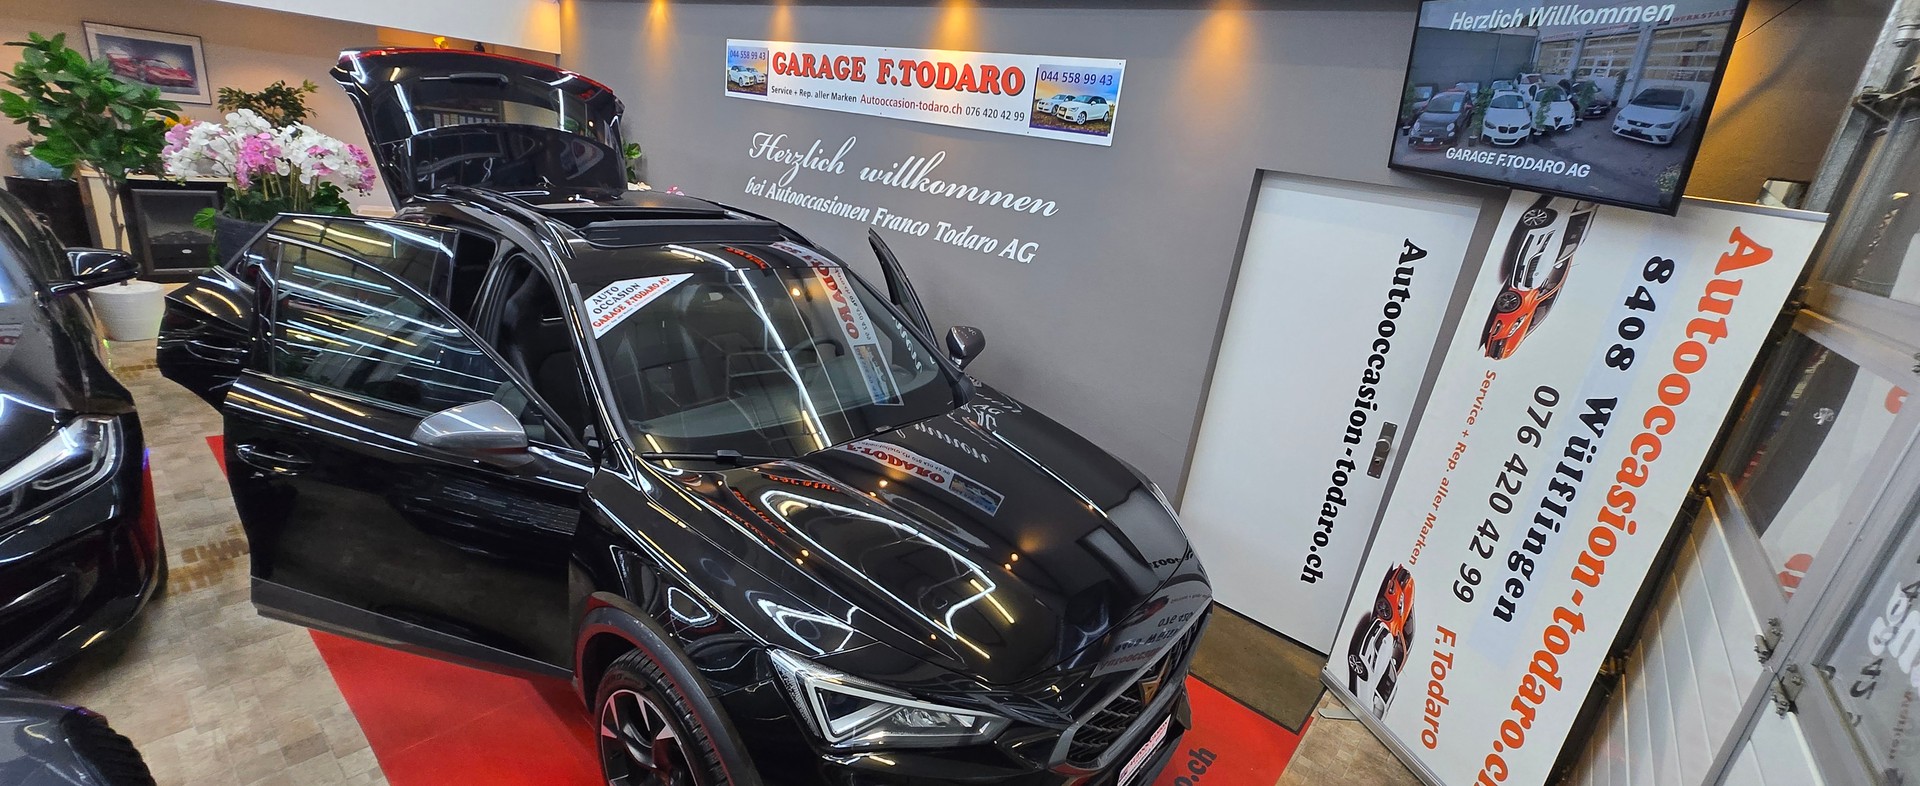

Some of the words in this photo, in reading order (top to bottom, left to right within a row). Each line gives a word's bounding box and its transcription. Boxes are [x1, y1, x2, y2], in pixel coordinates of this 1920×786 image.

[1449, 7, 1524, 31] Herzlich
[1528, 4, 1676, 27] Willkommen
[729, 50, 740, 58] 044
[740, 51, 750, 59] 558
[751, 51, 758, 60] 99
[758, 52, 766, 60] 43
[772, 51, 867, 83] GARAGE
[876, 57, 1025, 97] F.TODARO
[1040, 70, 1059, 82] 044
[1062, 71, 1080, 84] 558
[1083, 72, 1097, 85] 99
[1099, 74, 1113, 87] 43
[771, 85, 793, 96] Service
[799, 88, 813, 100] Rep.
[814, 90, 830, 100] aller
[830, 92, 857, 103] Marken
[860, 94, 963, 116] Autooccasion-todaro.ch
[965, 106, 981, 117] 076
[982, 108, 999, 120] 420
[1000, 110, 1012, 121] 42
[1013, 111, 1025, 123] 99
[748, 131, 857, 188] Herzlich
[859, 150, 1059, 217] willkommen
[1445, 147, 1497, 165] GARAGE
[1496, 153, 1566, 175] F.TODARO
[1565, 163, 1591, 178] AG
[744, 175, 767, 197] bei
[764, 182, 871, 222] Autooccasionen
[870, 206, 931, 237] Franco
[933, 221, 999, 254] Todaro
[998, 238, 1040, 264] AG
[592, 286, 620, 305] AUTO
[592, 282, 642, 315] OCCASION
[592, 303, 627, 328] GARAGE
[1604, 255, 1675, 373] 8408
[1300, 237, 1428, 585] Autooccasion-todaro.ch
[1466, 369, 1497, 426] Service
[1517, 384, 1560, 449] 076
[1446, 441, 1467, 472] Rep.
[1433, 476, 1450, 511] aller
[1489, 453, 1529, 515] 420
[1493, 396, 1619, 623] Wülflingen
[1408, 512, 1437, 566] Marken
[1469, 518, 1500, 560] 42
[1453, 562, 1482, 603] 99
